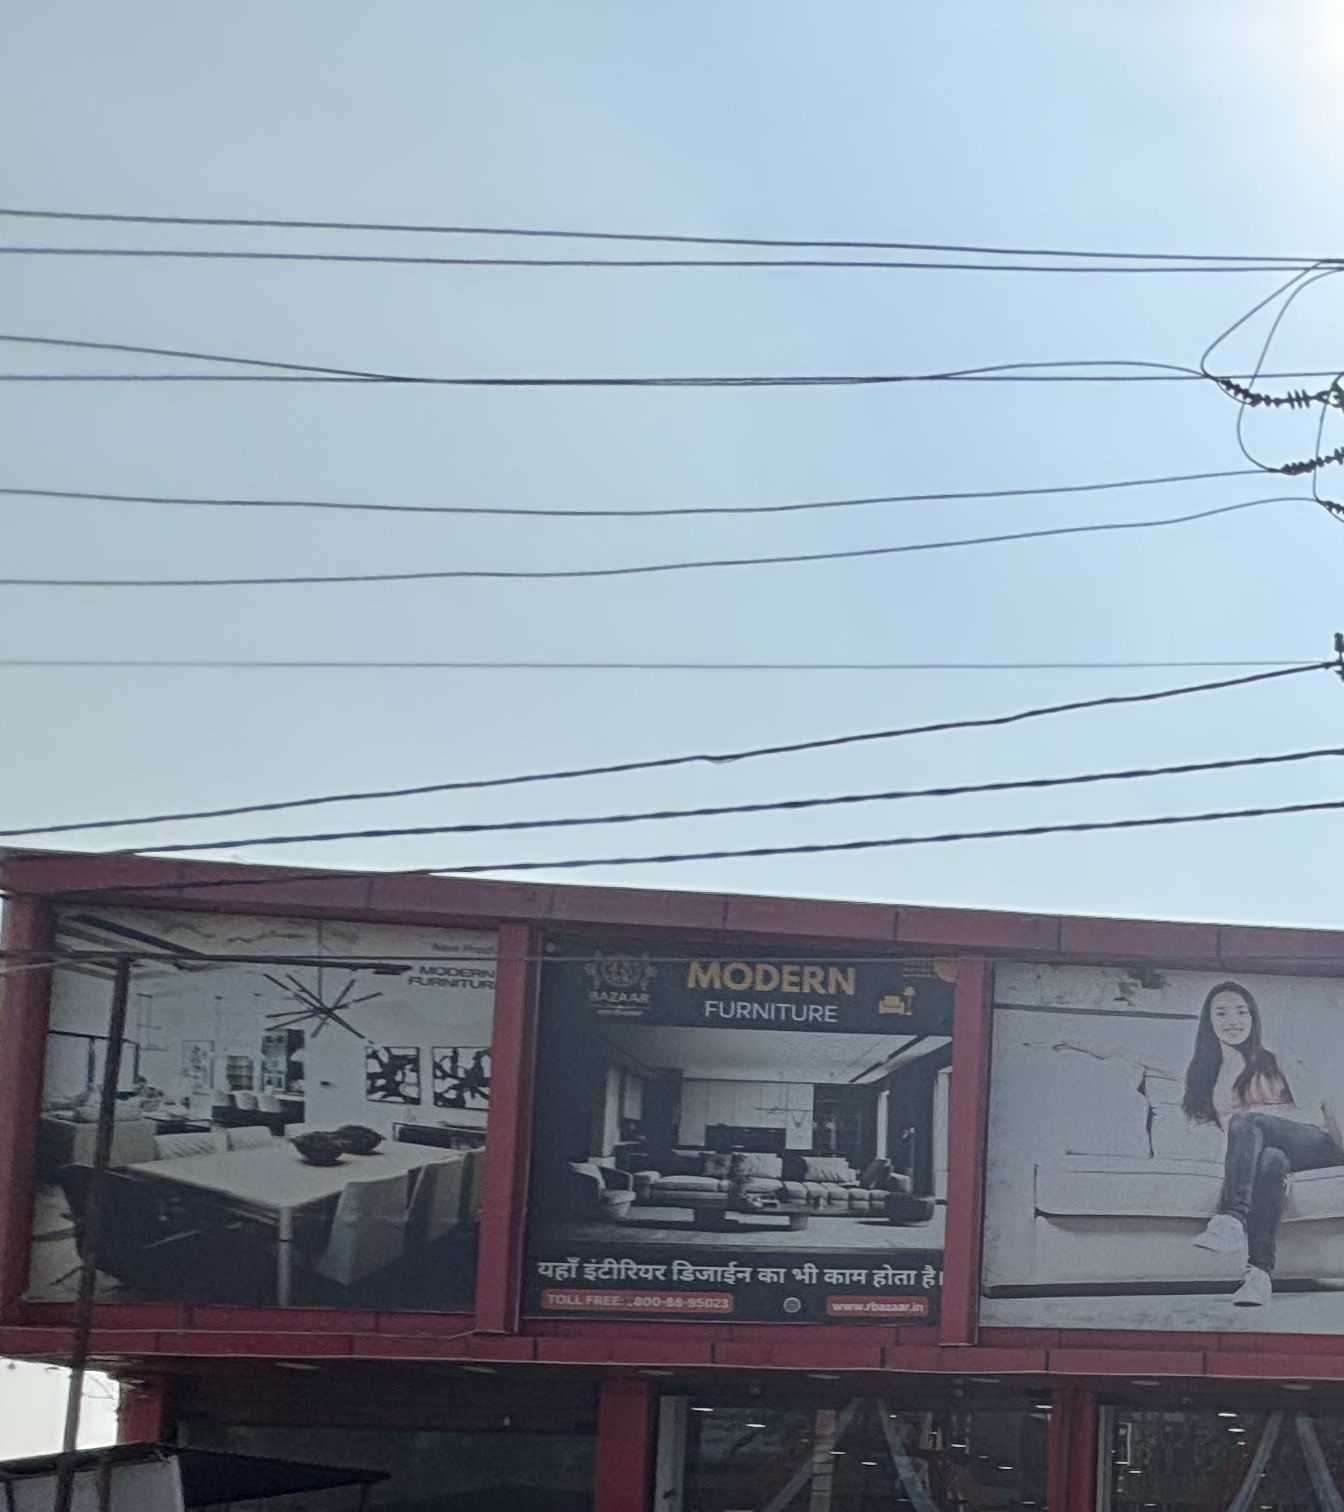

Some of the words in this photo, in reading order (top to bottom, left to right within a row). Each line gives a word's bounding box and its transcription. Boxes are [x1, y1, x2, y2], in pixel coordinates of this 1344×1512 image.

[687, 961, 856, 996] MODERN
[705, 1000, 839, 1023] FURNITURE
[537, 1257, 579, 1281] यहाँ
[583, 1259, 667, 1281] इंटीरियर
[672, 1260, 753, 1285] डिजाईन
[757, 1266, 787, 1284] का
[792, 1263, 819, 1285] भी
[823, 1269, 868, 1285] काम
[872, 1263, 918, 1288] होता
[547, 1294, 582, 1306] TOLL
